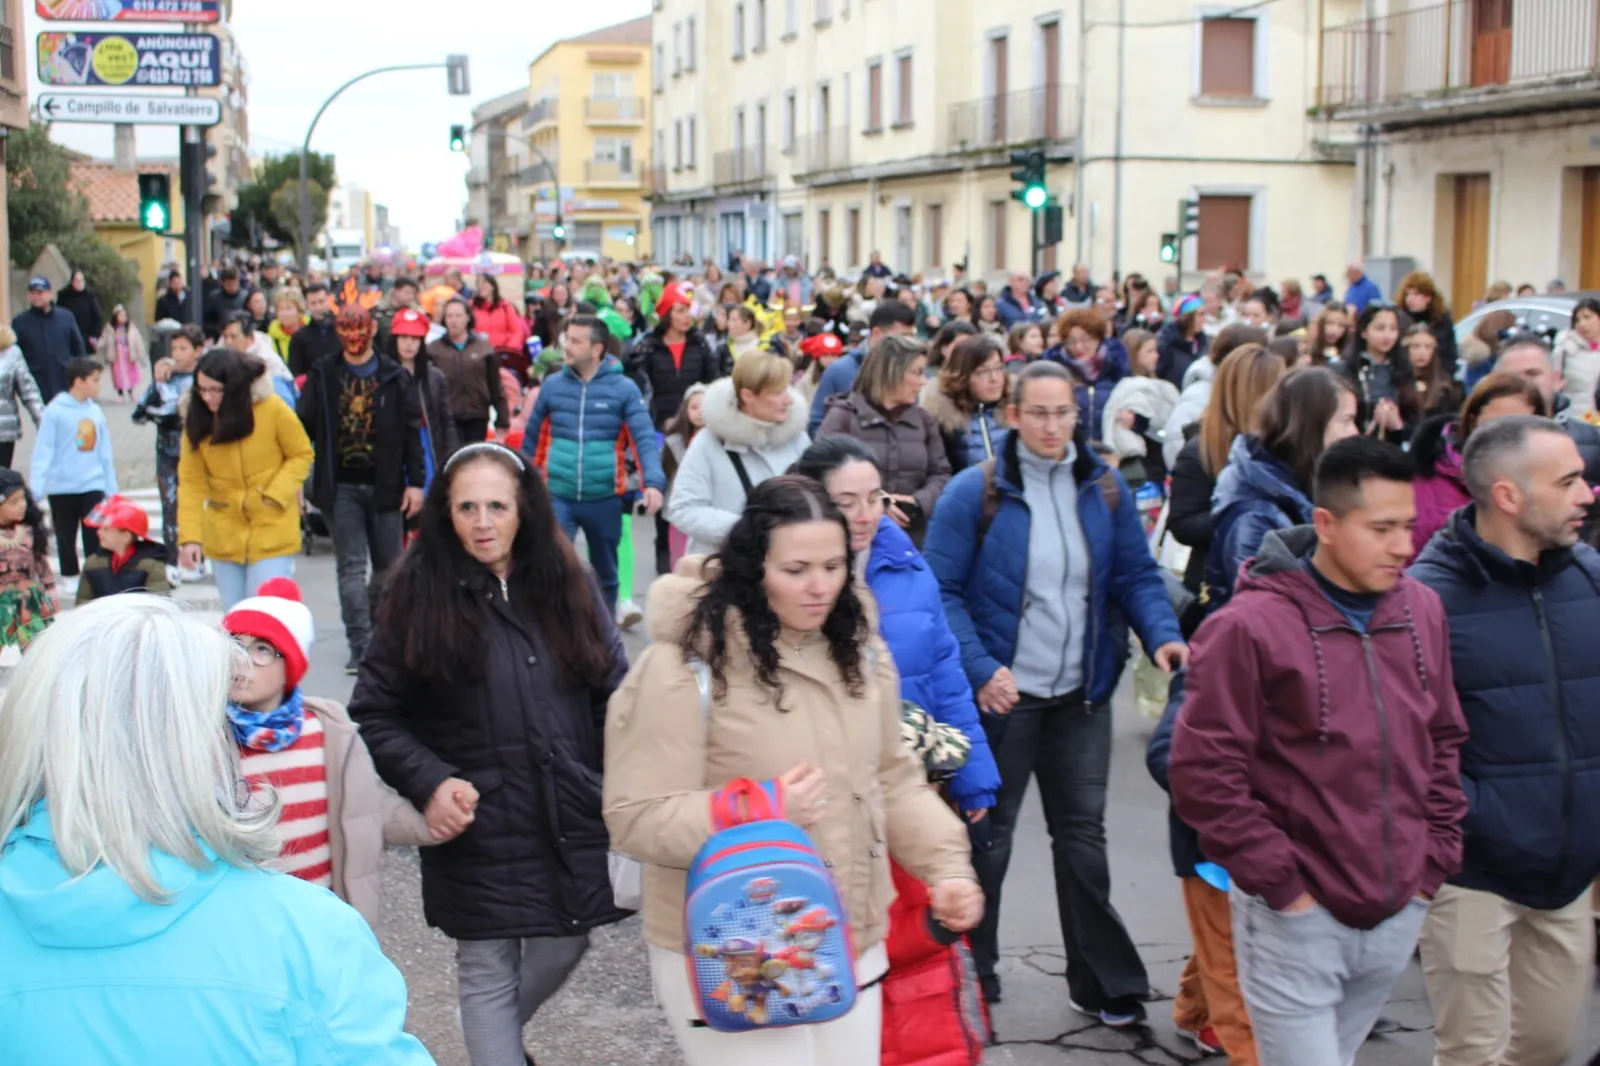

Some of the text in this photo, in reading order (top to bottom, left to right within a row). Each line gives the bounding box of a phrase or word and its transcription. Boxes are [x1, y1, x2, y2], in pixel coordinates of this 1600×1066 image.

[67, 99, 213, 117] Campillo de Salvatierra
